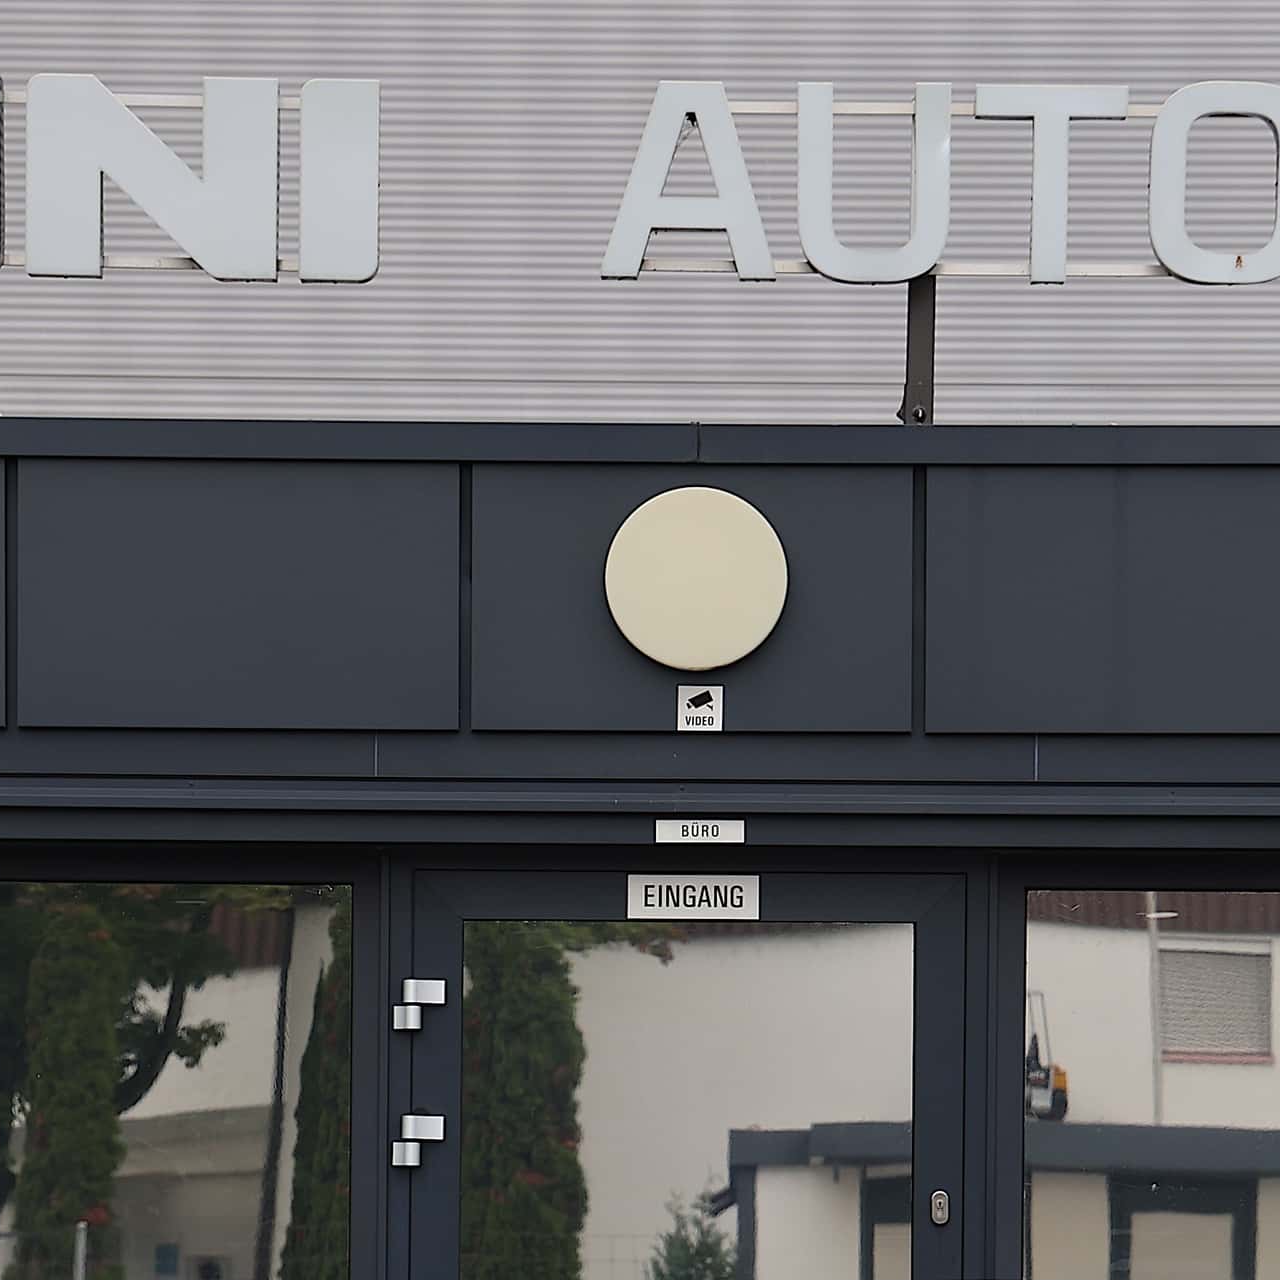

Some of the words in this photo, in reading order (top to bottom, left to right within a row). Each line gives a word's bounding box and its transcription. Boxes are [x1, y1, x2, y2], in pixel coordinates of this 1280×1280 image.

[685, 715, 715, 727] VIDEO
[681, 821, 720, 838] BÜRO
[643, 884, 745, 909] EINGANG
